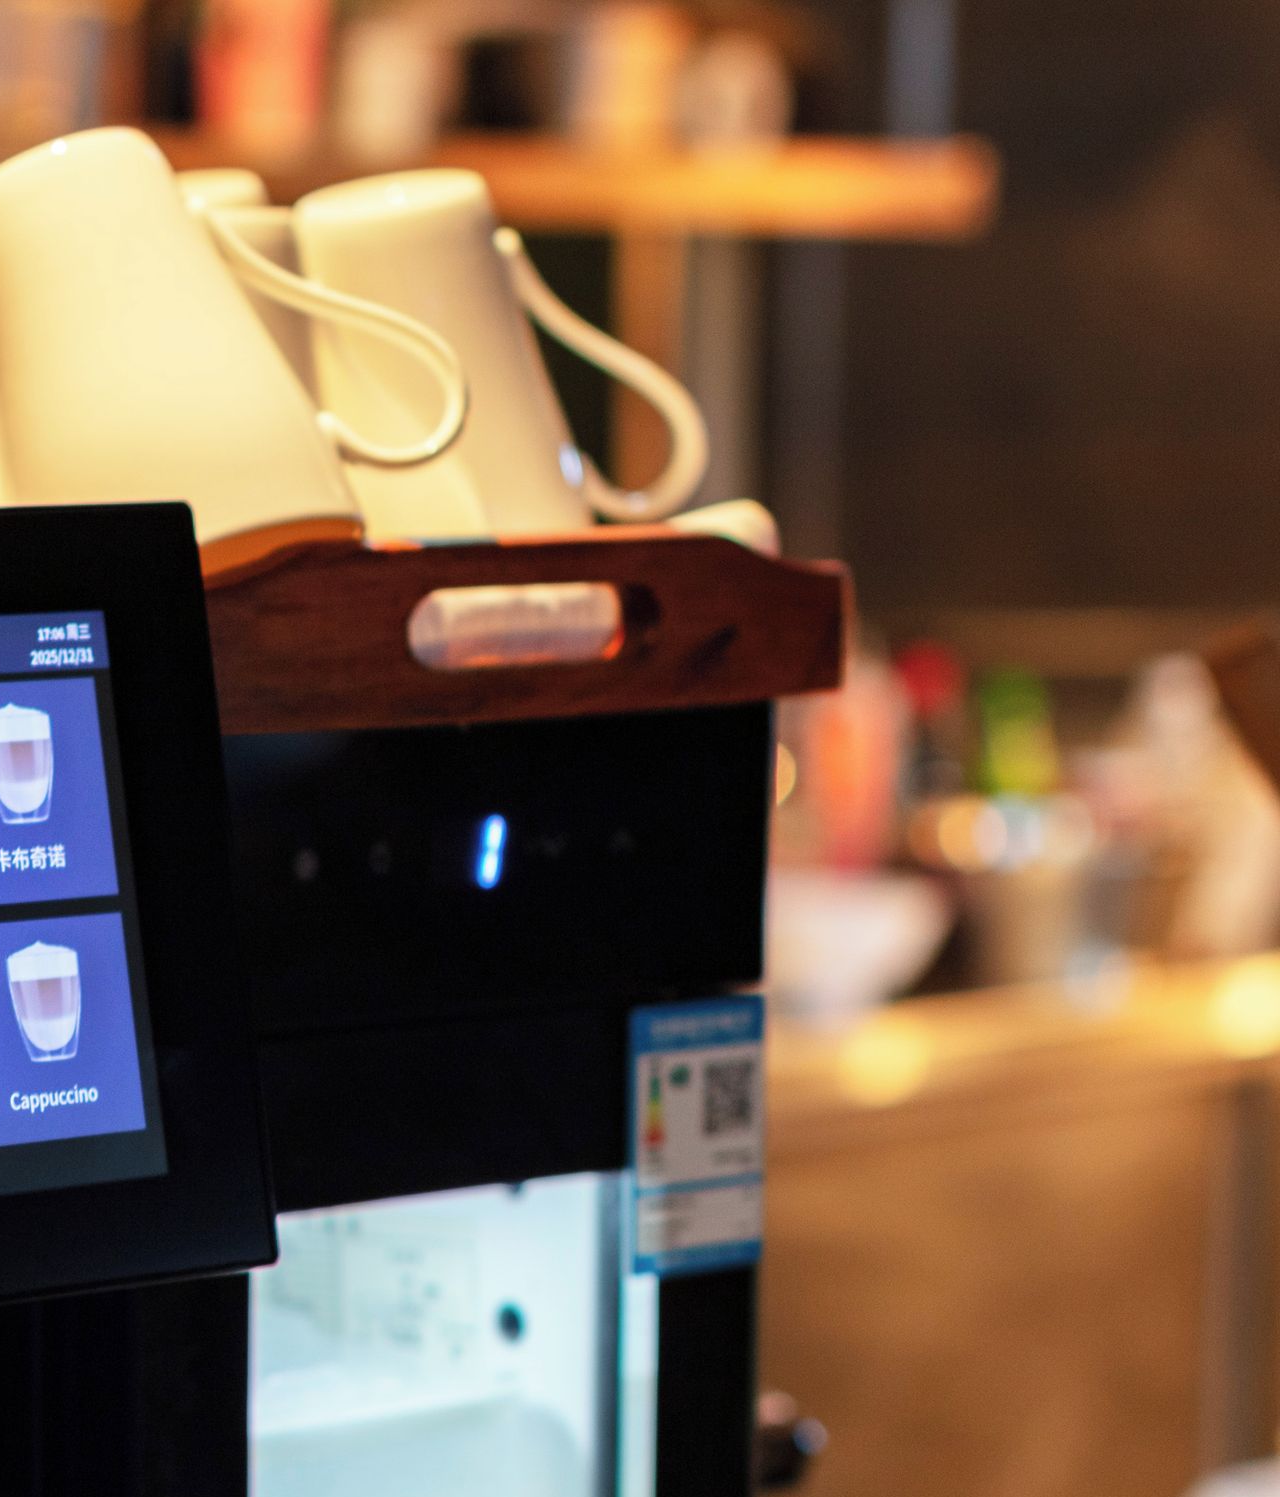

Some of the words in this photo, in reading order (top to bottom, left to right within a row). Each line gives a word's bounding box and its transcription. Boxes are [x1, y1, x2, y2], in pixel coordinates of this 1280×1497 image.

[37, 626, 65, 641] 17:06
[30, 646, 93, 667] 2025/12/31
[10, 1083, 99, 1114] Cappuccino
